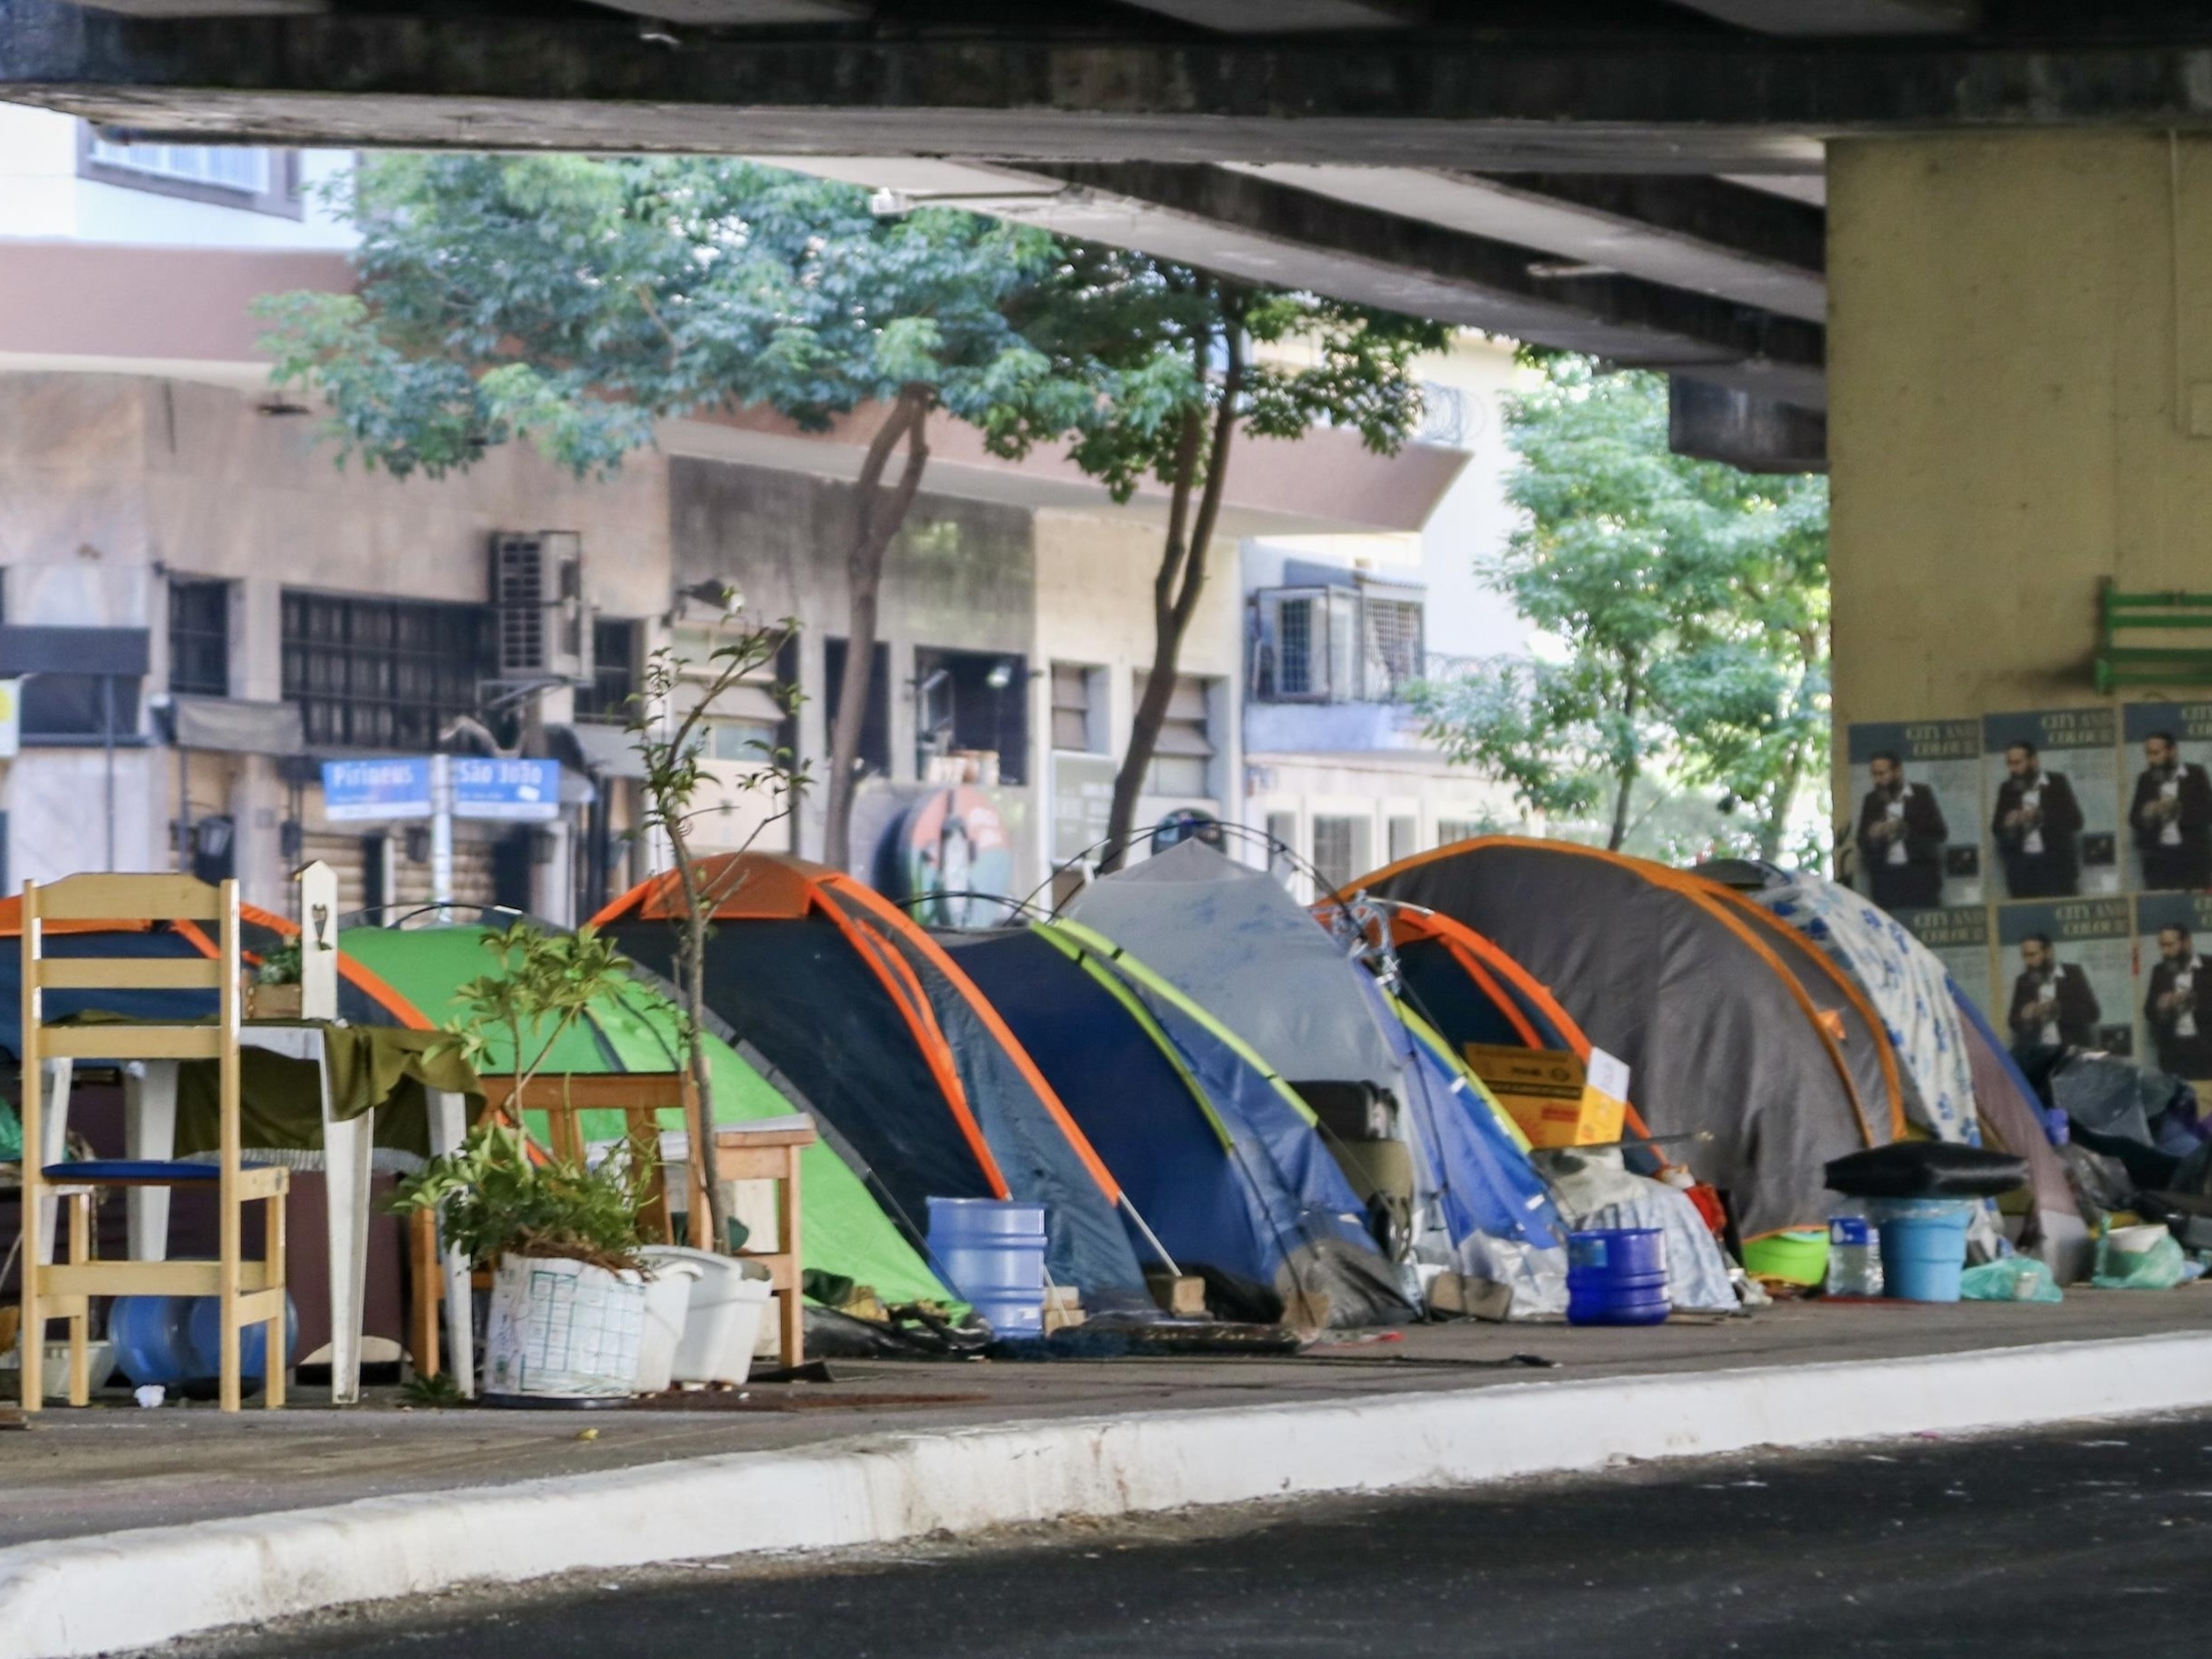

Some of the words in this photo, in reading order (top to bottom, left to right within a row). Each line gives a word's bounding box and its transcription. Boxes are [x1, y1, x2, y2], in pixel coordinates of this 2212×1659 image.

[2040, 713, 2076, 729] CITY
[1906, 725, 1940, 740] CITY
[458, 760, 494, 784] São
[498, 761, 544, 785] João
[1913, 911, 1948, 927] CITY
[2056, 904, 2090, 920] CITY
